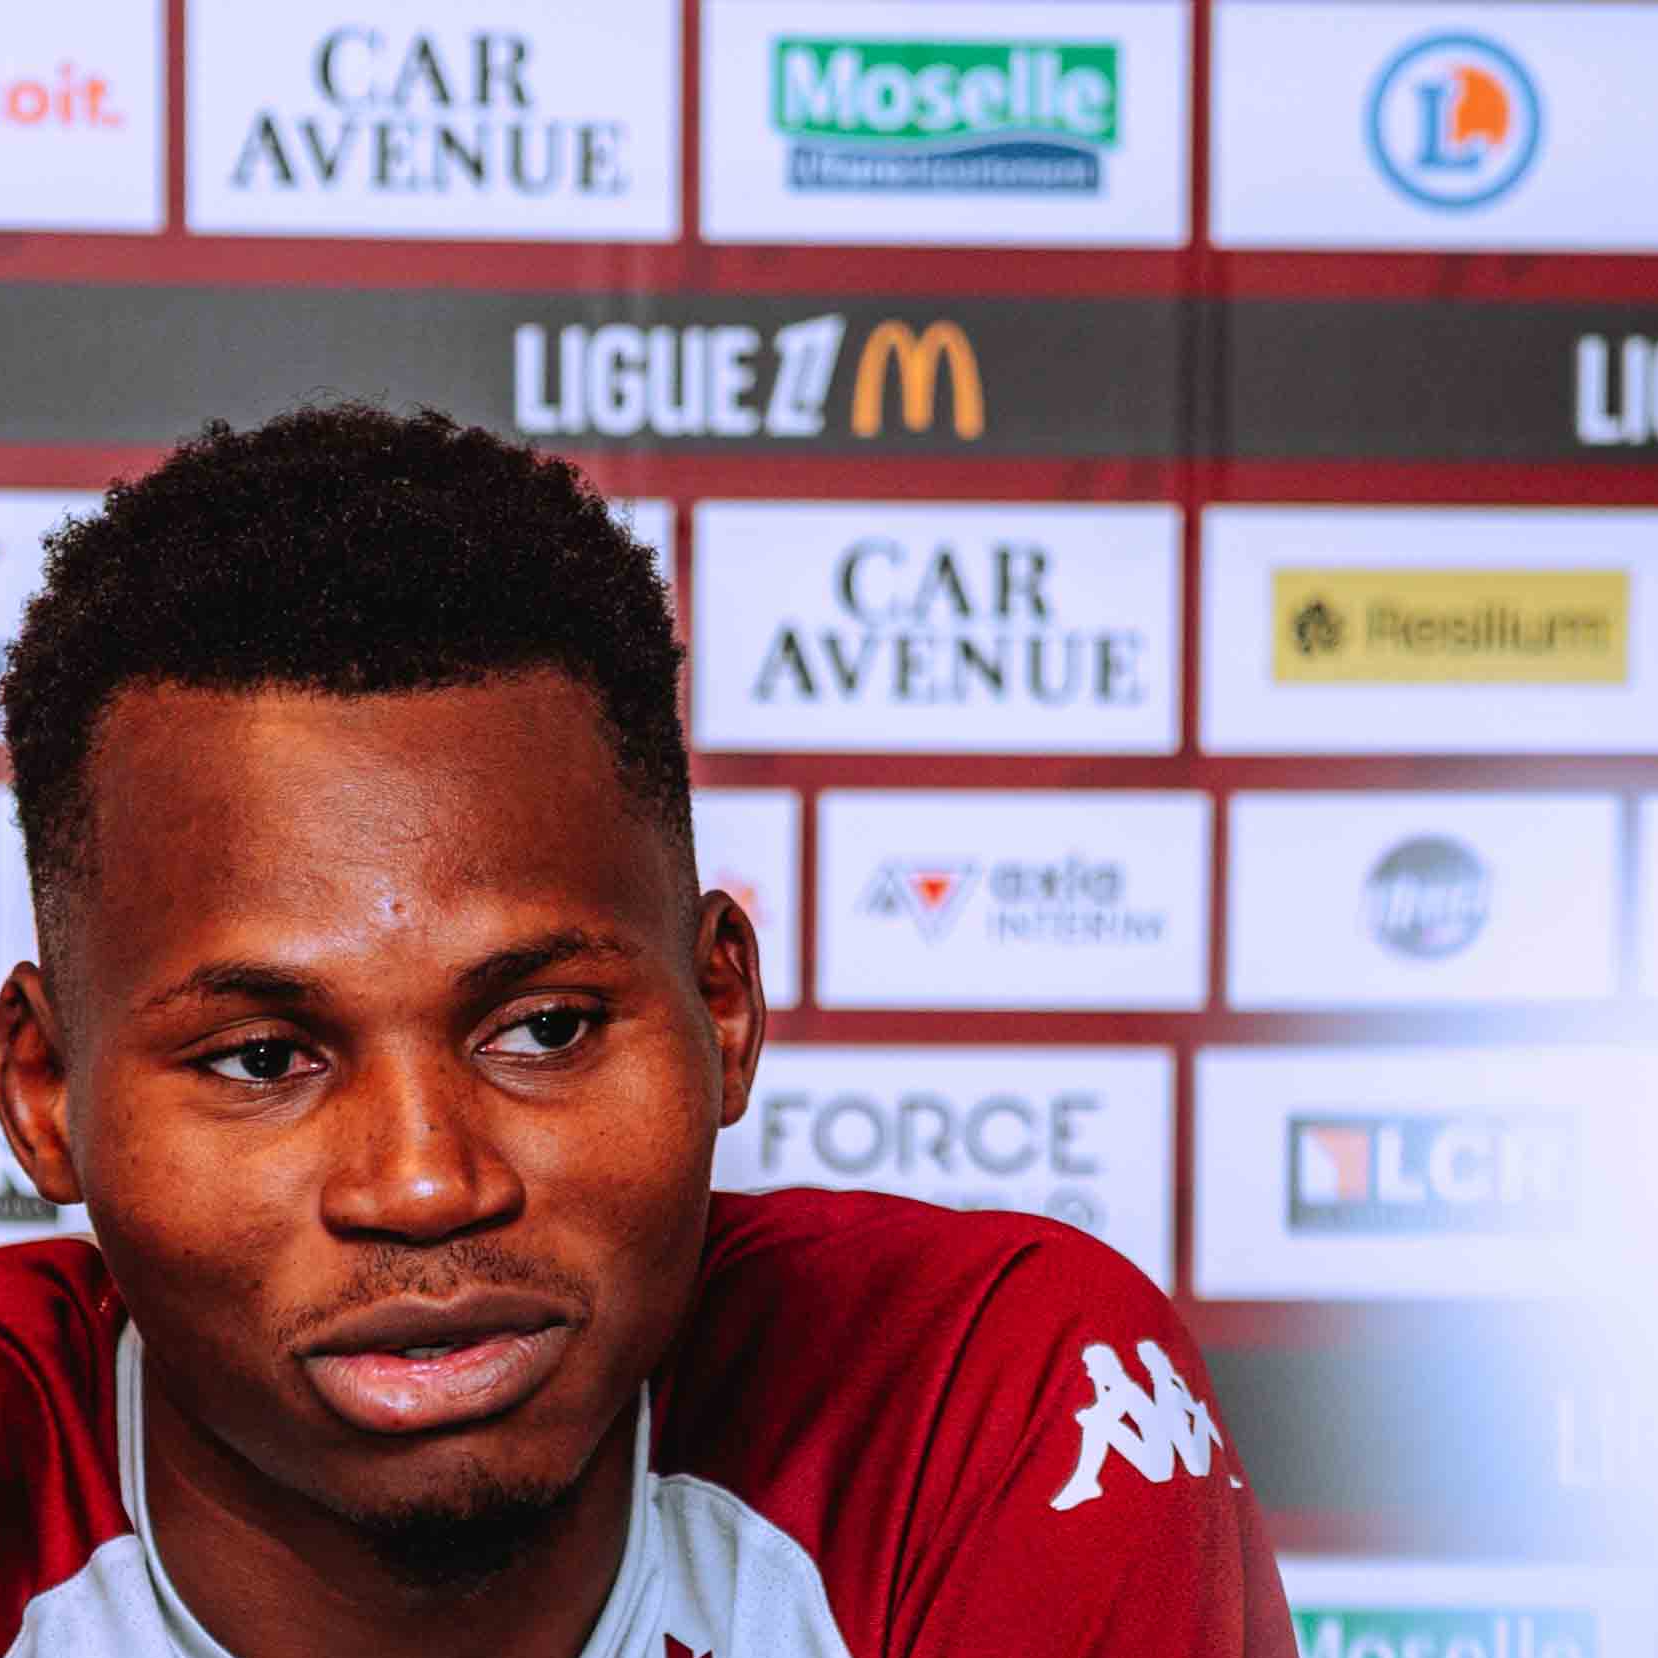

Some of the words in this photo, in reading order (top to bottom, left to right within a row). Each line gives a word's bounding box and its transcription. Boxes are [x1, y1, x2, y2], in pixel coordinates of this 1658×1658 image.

[315, 30, 532, 109] CAR
[786, 48, 1111, 134] Moselle
[231, 112, 629, 195] AVENUE
[836, 541, 1050, 621] CAR
[755, 628, 1142, 705] AVENUE
[759, 1092, 1103, 1177] FORCE
